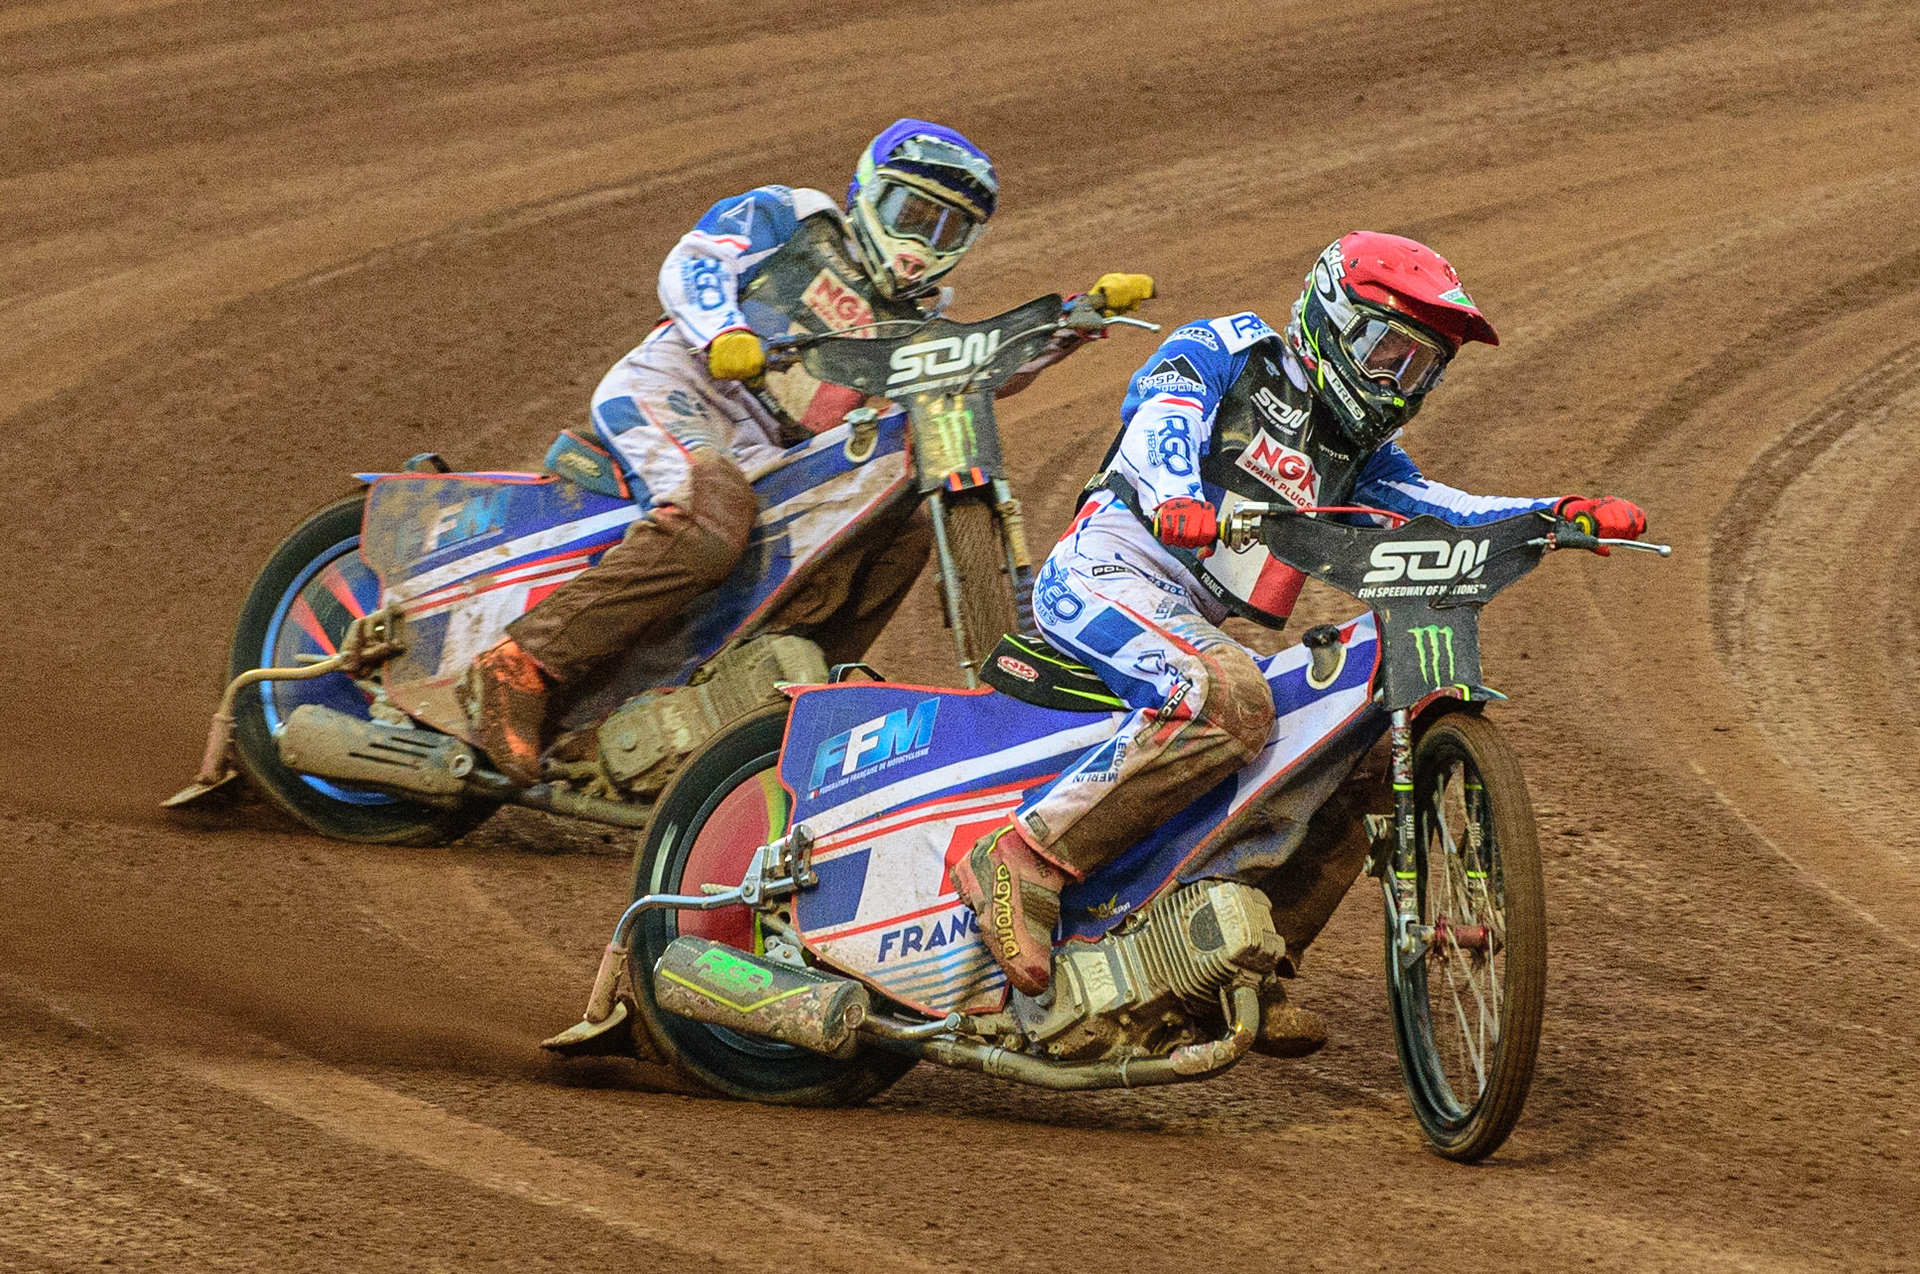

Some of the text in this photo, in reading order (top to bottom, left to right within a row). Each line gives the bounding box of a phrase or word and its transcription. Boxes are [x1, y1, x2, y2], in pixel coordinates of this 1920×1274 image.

[886, 328, 1001, 386] SON
[1254, 386, 1311, 429] SON
[1243, 459, 1314, 509] SPARK PLUGS
[1251, 435, 1317, 500] NGK
[1200, 572, 1225, 598] FRANCE
[1362, 539, 1491, 583] SON
[1357, 587, 1376, 599] FIM
[1376, 585, 1426, 598] SPEEDWAY
[1425, 584, 1438, 596] OF
[807, 696, 941, 792] FFM
[1072, 772, 1118, 783] MERLIN
[994, 863, 1020, 959] daytona
[877, 910, 981, 964] FRANC
